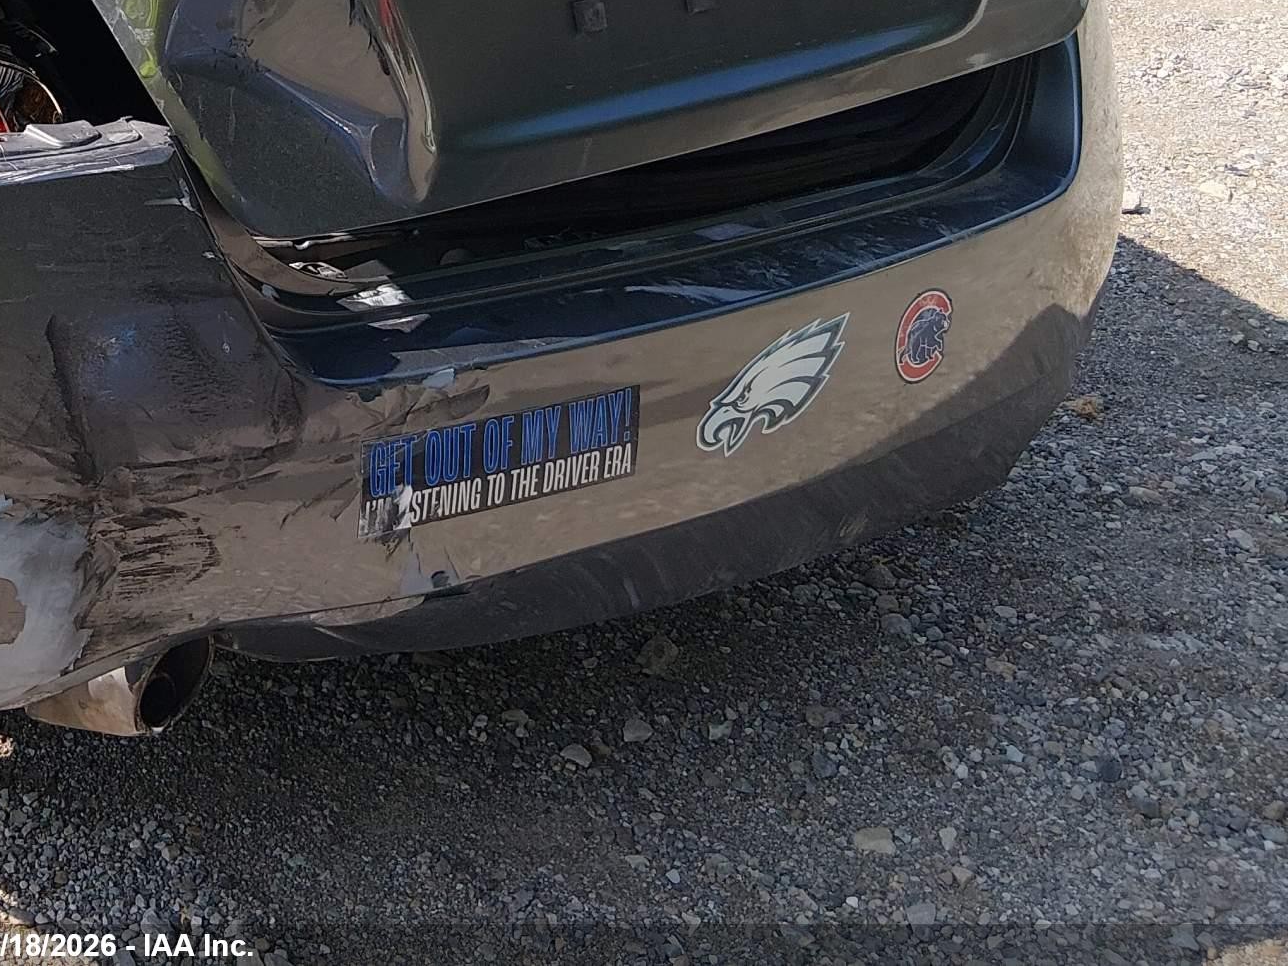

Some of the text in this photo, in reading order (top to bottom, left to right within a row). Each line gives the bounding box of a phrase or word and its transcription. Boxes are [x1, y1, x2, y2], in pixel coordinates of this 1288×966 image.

[369, 387, 632, 498] GET OUT OF MY WAY!
[486, 471, 506, 506] TO
[510, 461, 541, 501] THE
[541, 450, 601, 494] DRIVER
[603, 442, 632, 480] ERA
